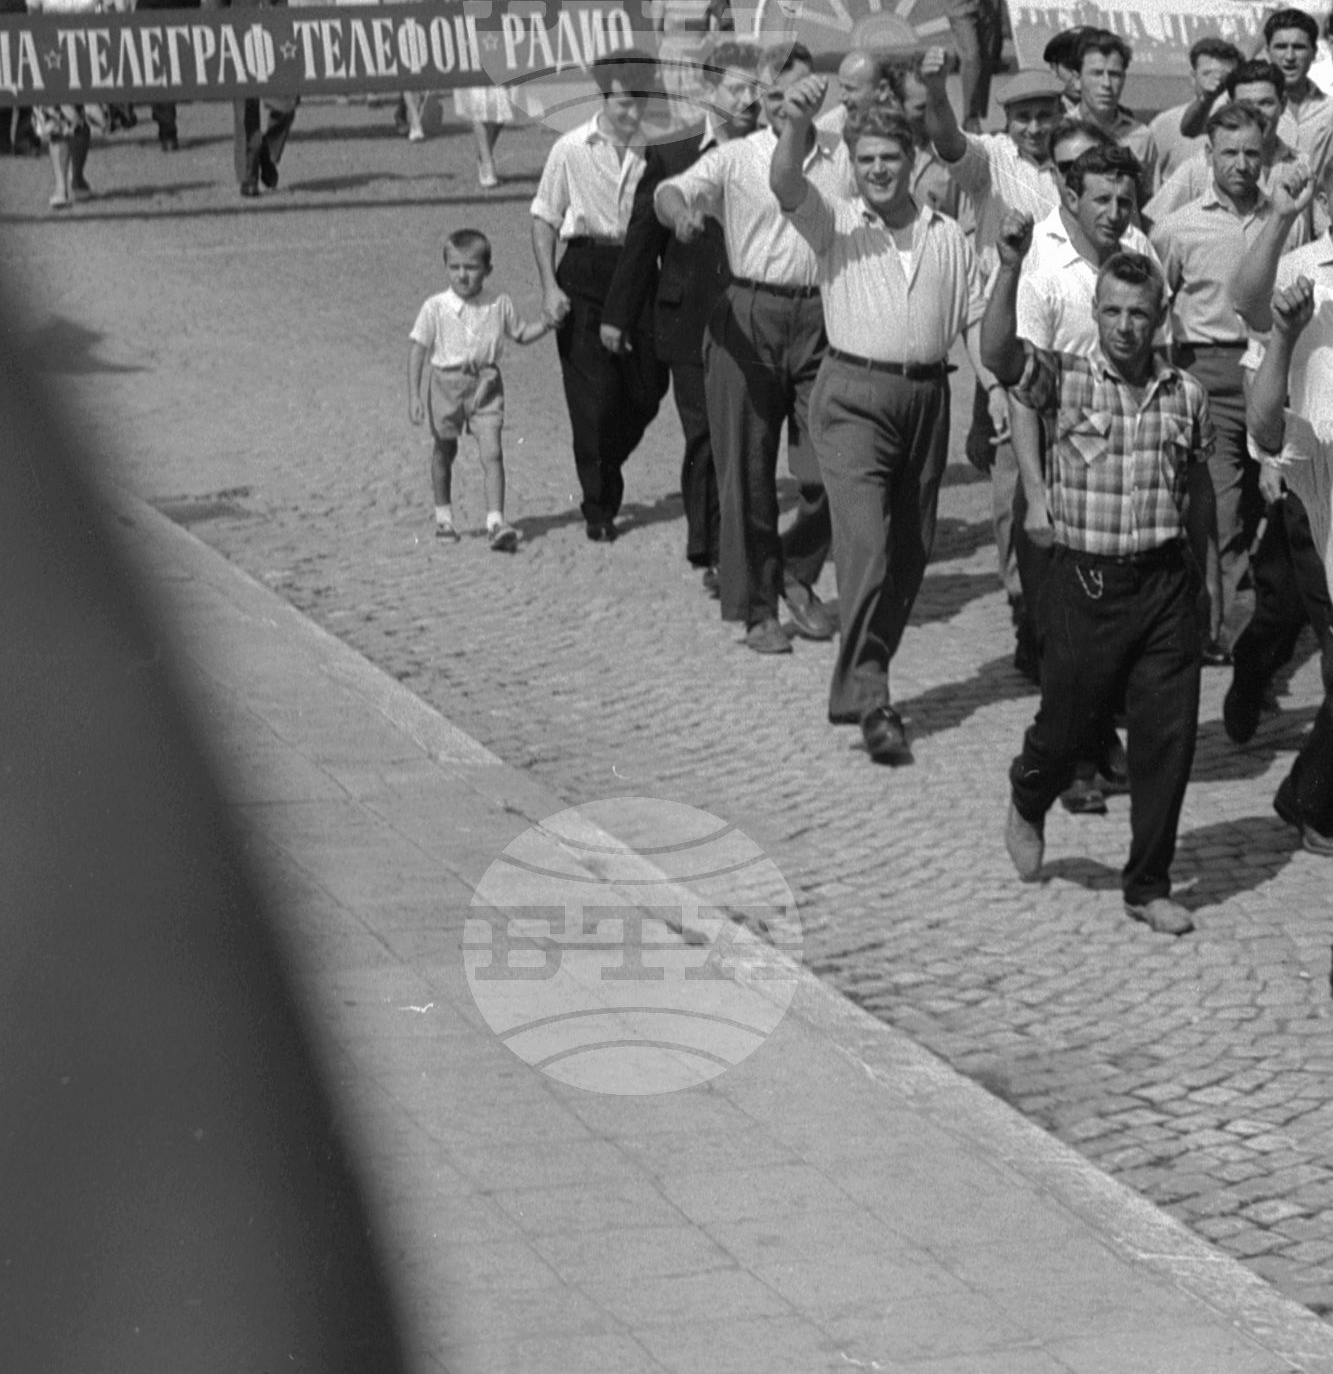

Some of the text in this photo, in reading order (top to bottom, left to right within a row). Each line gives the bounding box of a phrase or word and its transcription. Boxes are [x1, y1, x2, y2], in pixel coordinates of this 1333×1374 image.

[57, 23, 276, 89] ТЕЛЕГРАФ
[293, 14, 482, 80] ТЕЛЕФОН
[501, 8, 635, 74] РАДИО
